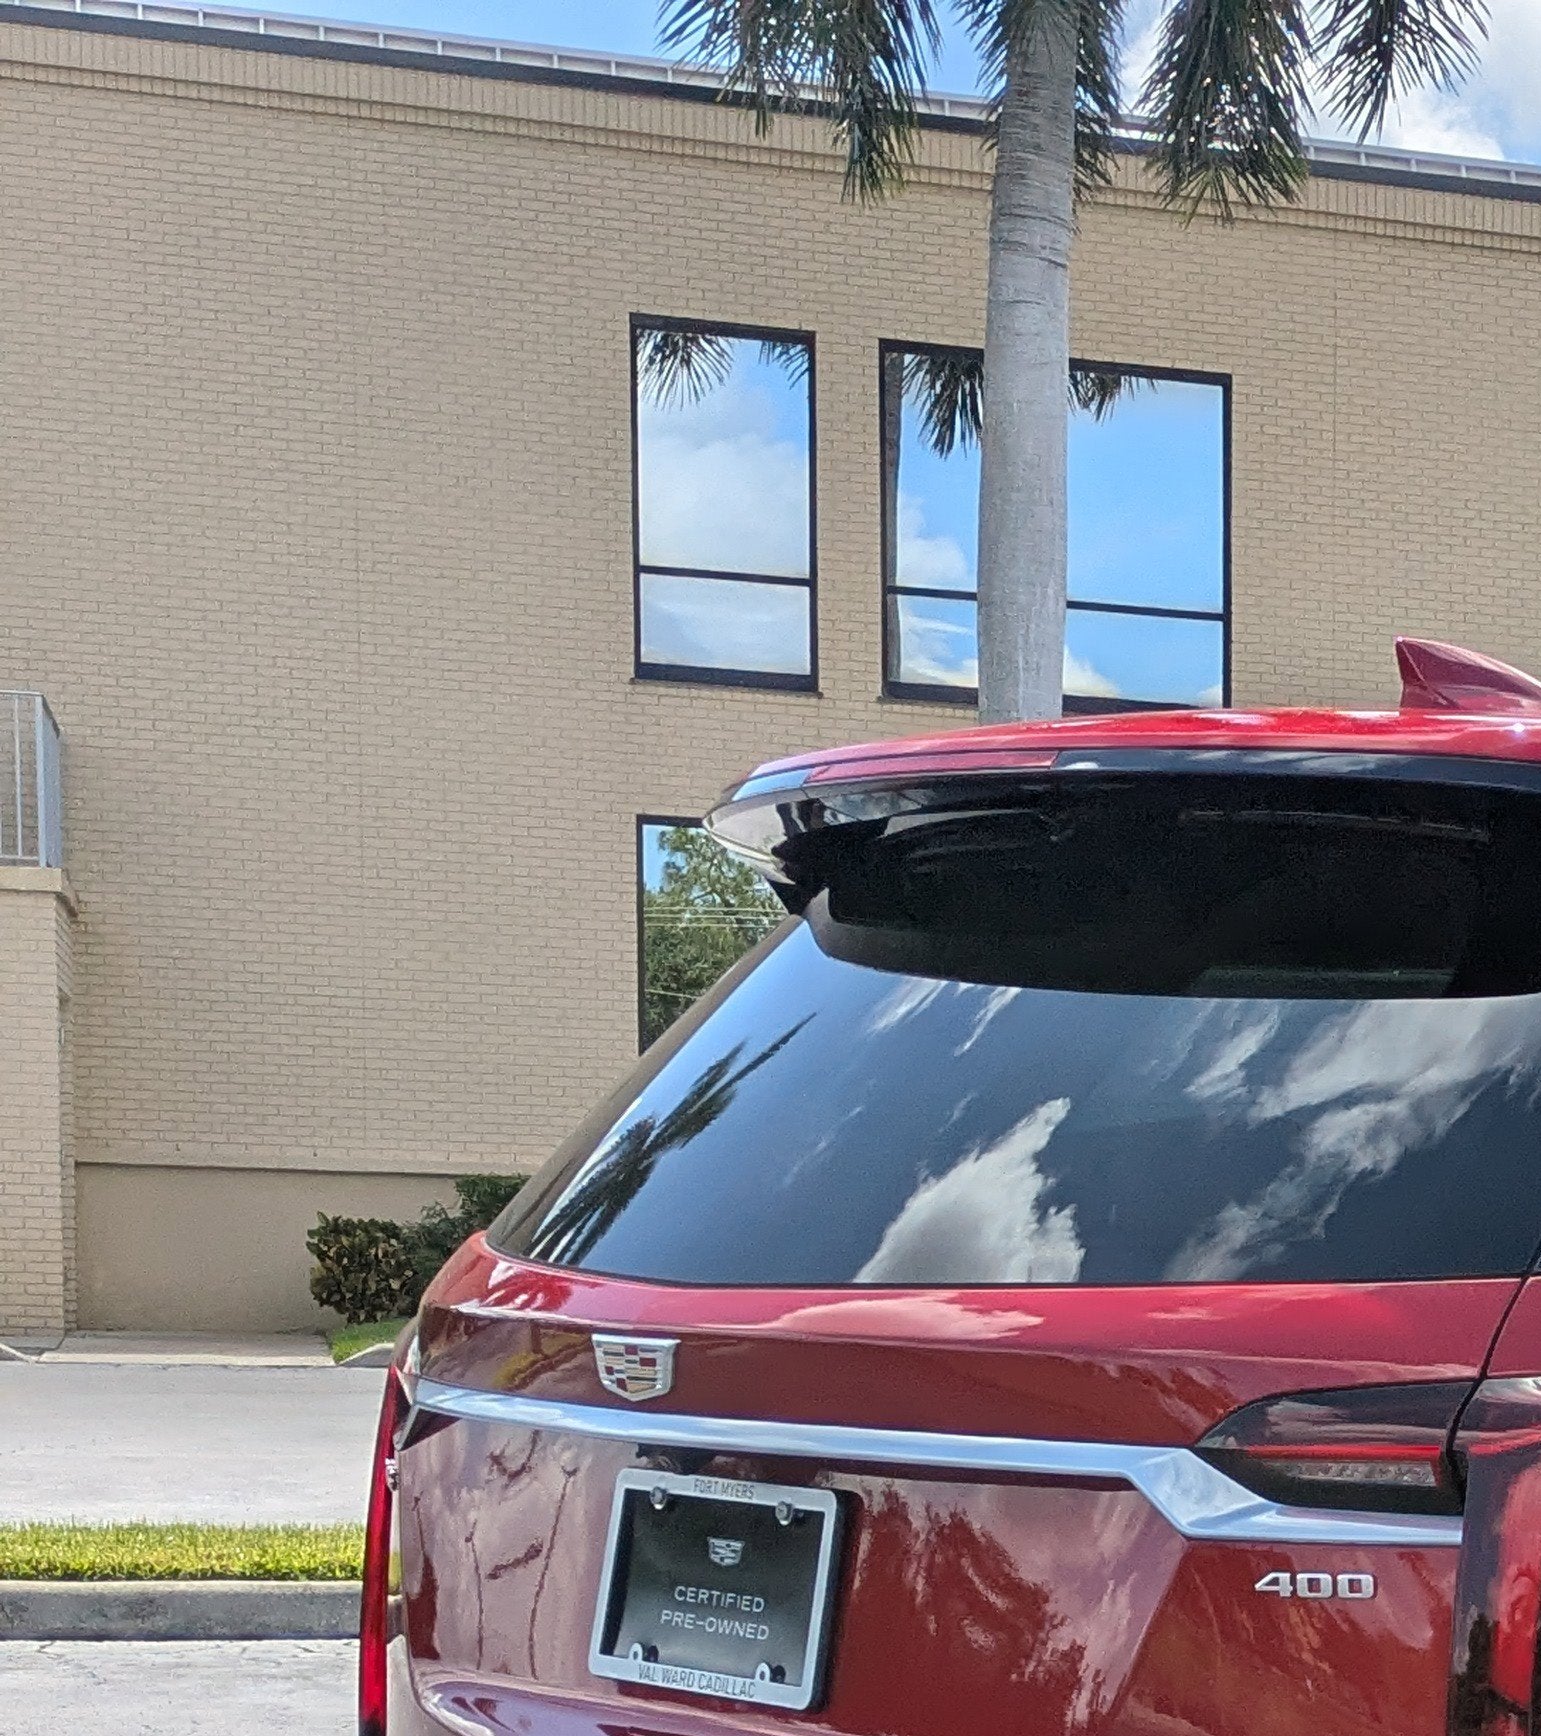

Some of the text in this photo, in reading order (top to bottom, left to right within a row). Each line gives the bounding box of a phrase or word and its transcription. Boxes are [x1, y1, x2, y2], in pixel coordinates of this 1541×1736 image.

[693, 1478, 755, 1499] FORT MYERS
[674, 1585, 765, 1613] CERTIFIED
[1254, 1571, 1375, 1599] 400
[659, 1609, 770, 1641] PRE-OWNED
[637, 1665, 757, 1699] VAL WARD CADILLAC
